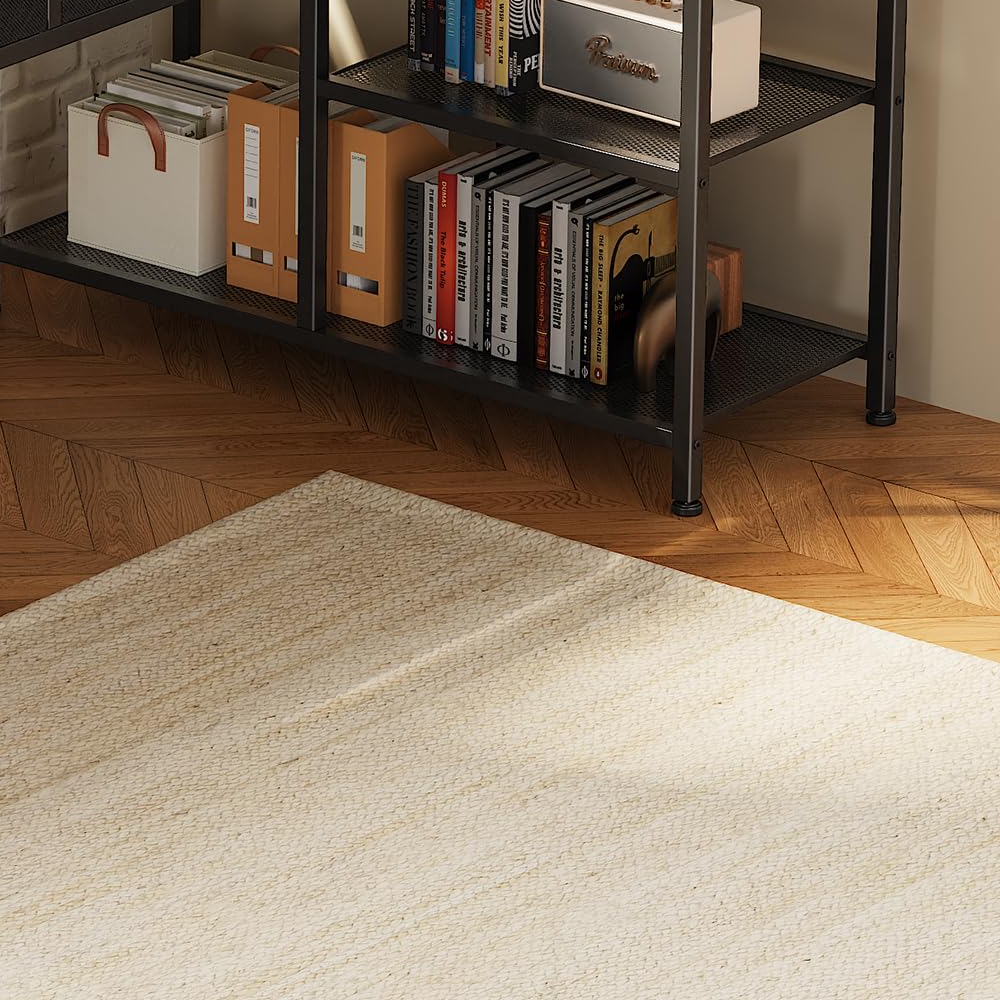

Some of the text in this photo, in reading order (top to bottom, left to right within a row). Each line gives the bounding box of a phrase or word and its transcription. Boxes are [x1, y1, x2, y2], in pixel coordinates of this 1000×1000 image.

[458, 220, 468, 238] arts
[406, 184, 419, 329] THE FASHION BOOK
[554, 247, 563, 265] arts
[457, 250, 468, 302] architecture
[553, 278, 564, 330] architecture
[614, 303, 624, 312] big
